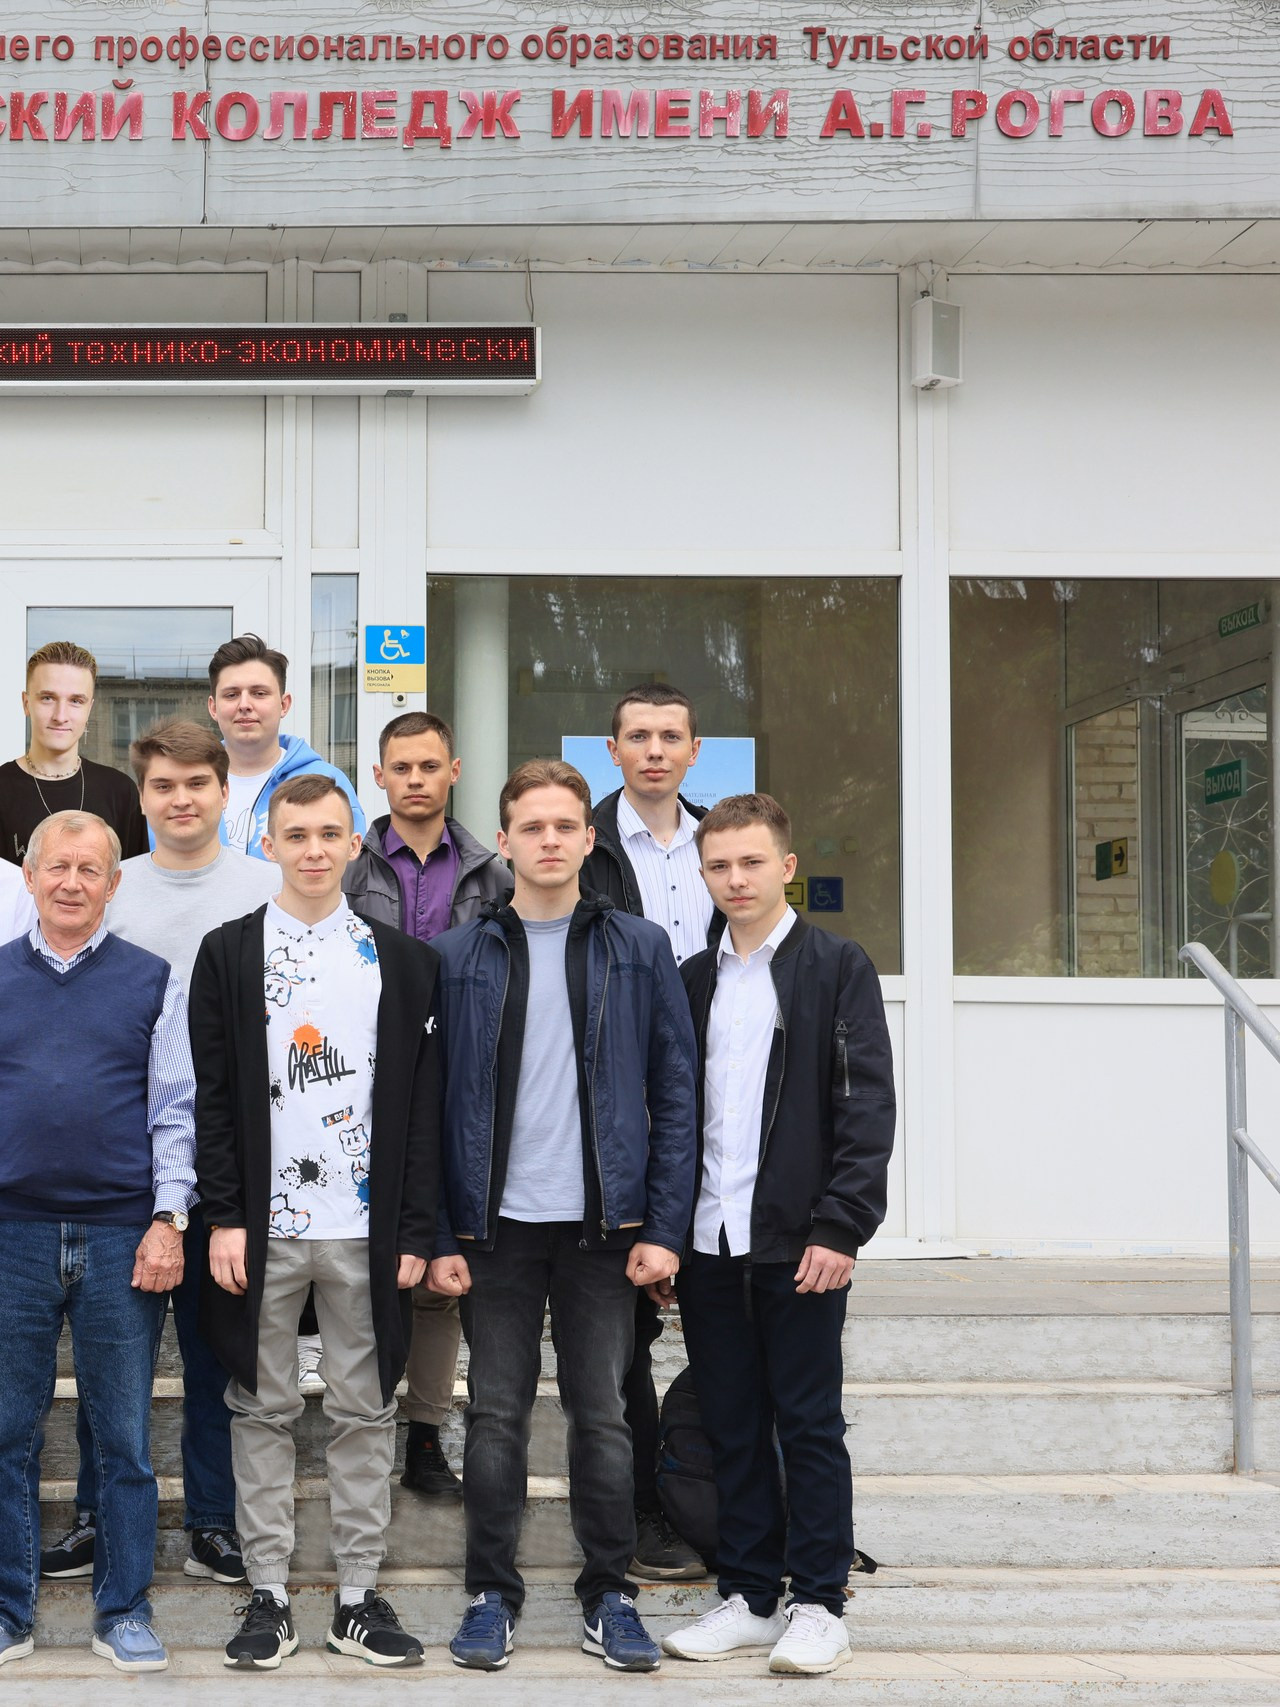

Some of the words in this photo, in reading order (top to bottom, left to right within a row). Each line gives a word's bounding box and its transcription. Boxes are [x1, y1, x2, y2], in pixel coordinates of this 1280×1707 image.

[94, 26, 510, 69] профессионального
[521, 25, 778, 67] образования
[1008, 28, 1172, 62] области
[172, 90, 522, 149] КОЛЛЕДЖ
[551, 89, 790, 139] ИМЕНИ
[68, 339, 529, 363] технико-экономически
[1221, 607, 1257, 633] ВЫХОД
[1206, 770, 1240, 796] ВЫХОД
